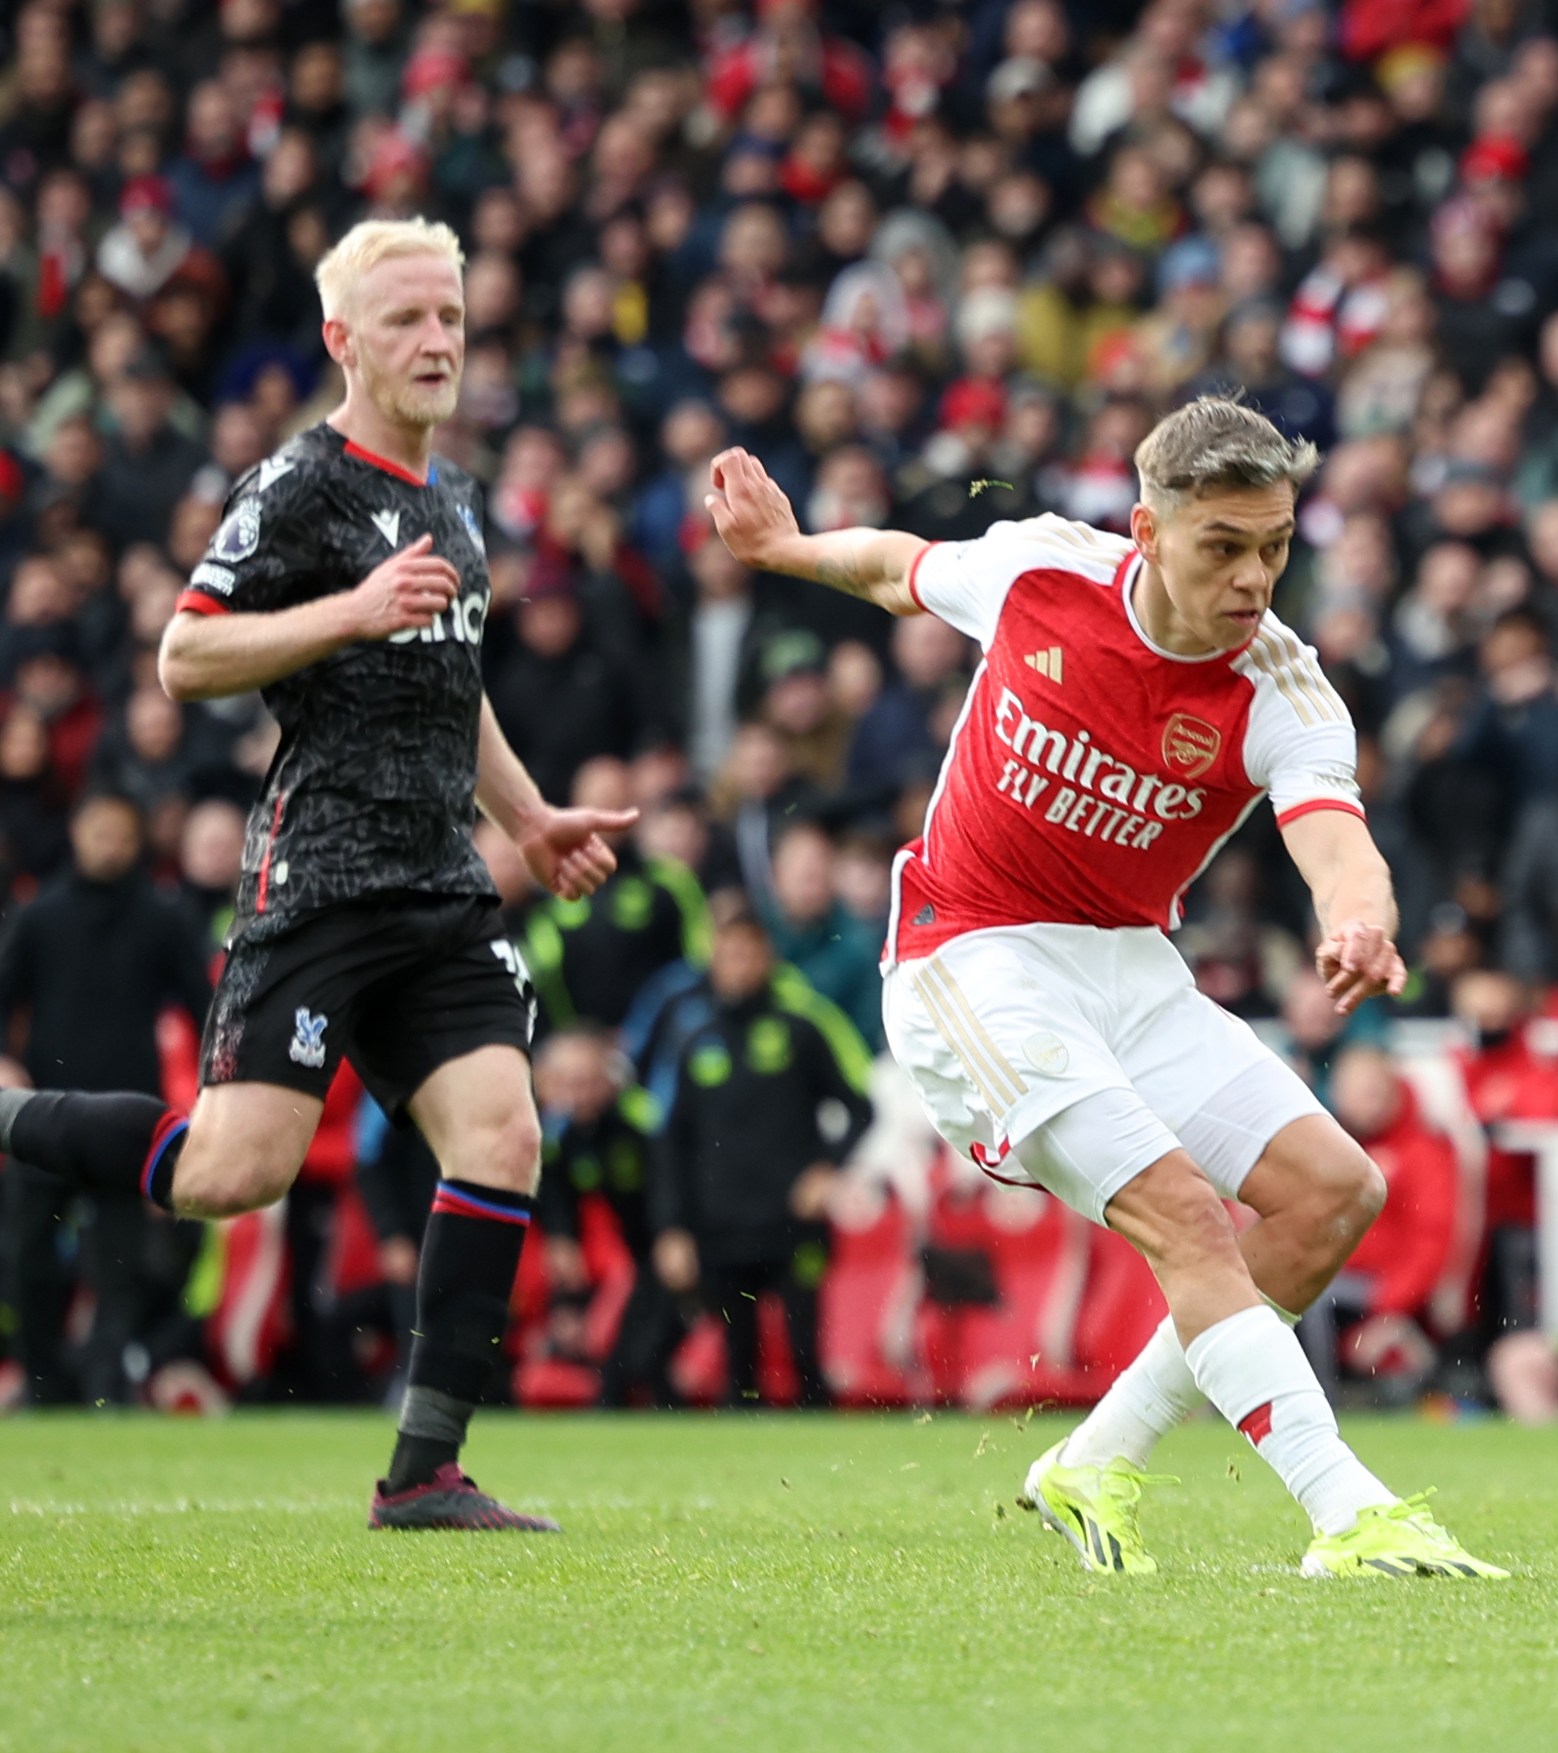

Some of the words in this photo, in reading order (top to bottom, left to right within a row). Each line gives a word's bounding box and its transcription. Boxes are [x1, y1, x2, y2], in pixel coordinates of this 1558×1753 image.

[995, 686, 1208, 821] Emirates
[997, 758, 1049, 810] FLY
[1044, 786, 1163, 850] BETTER
